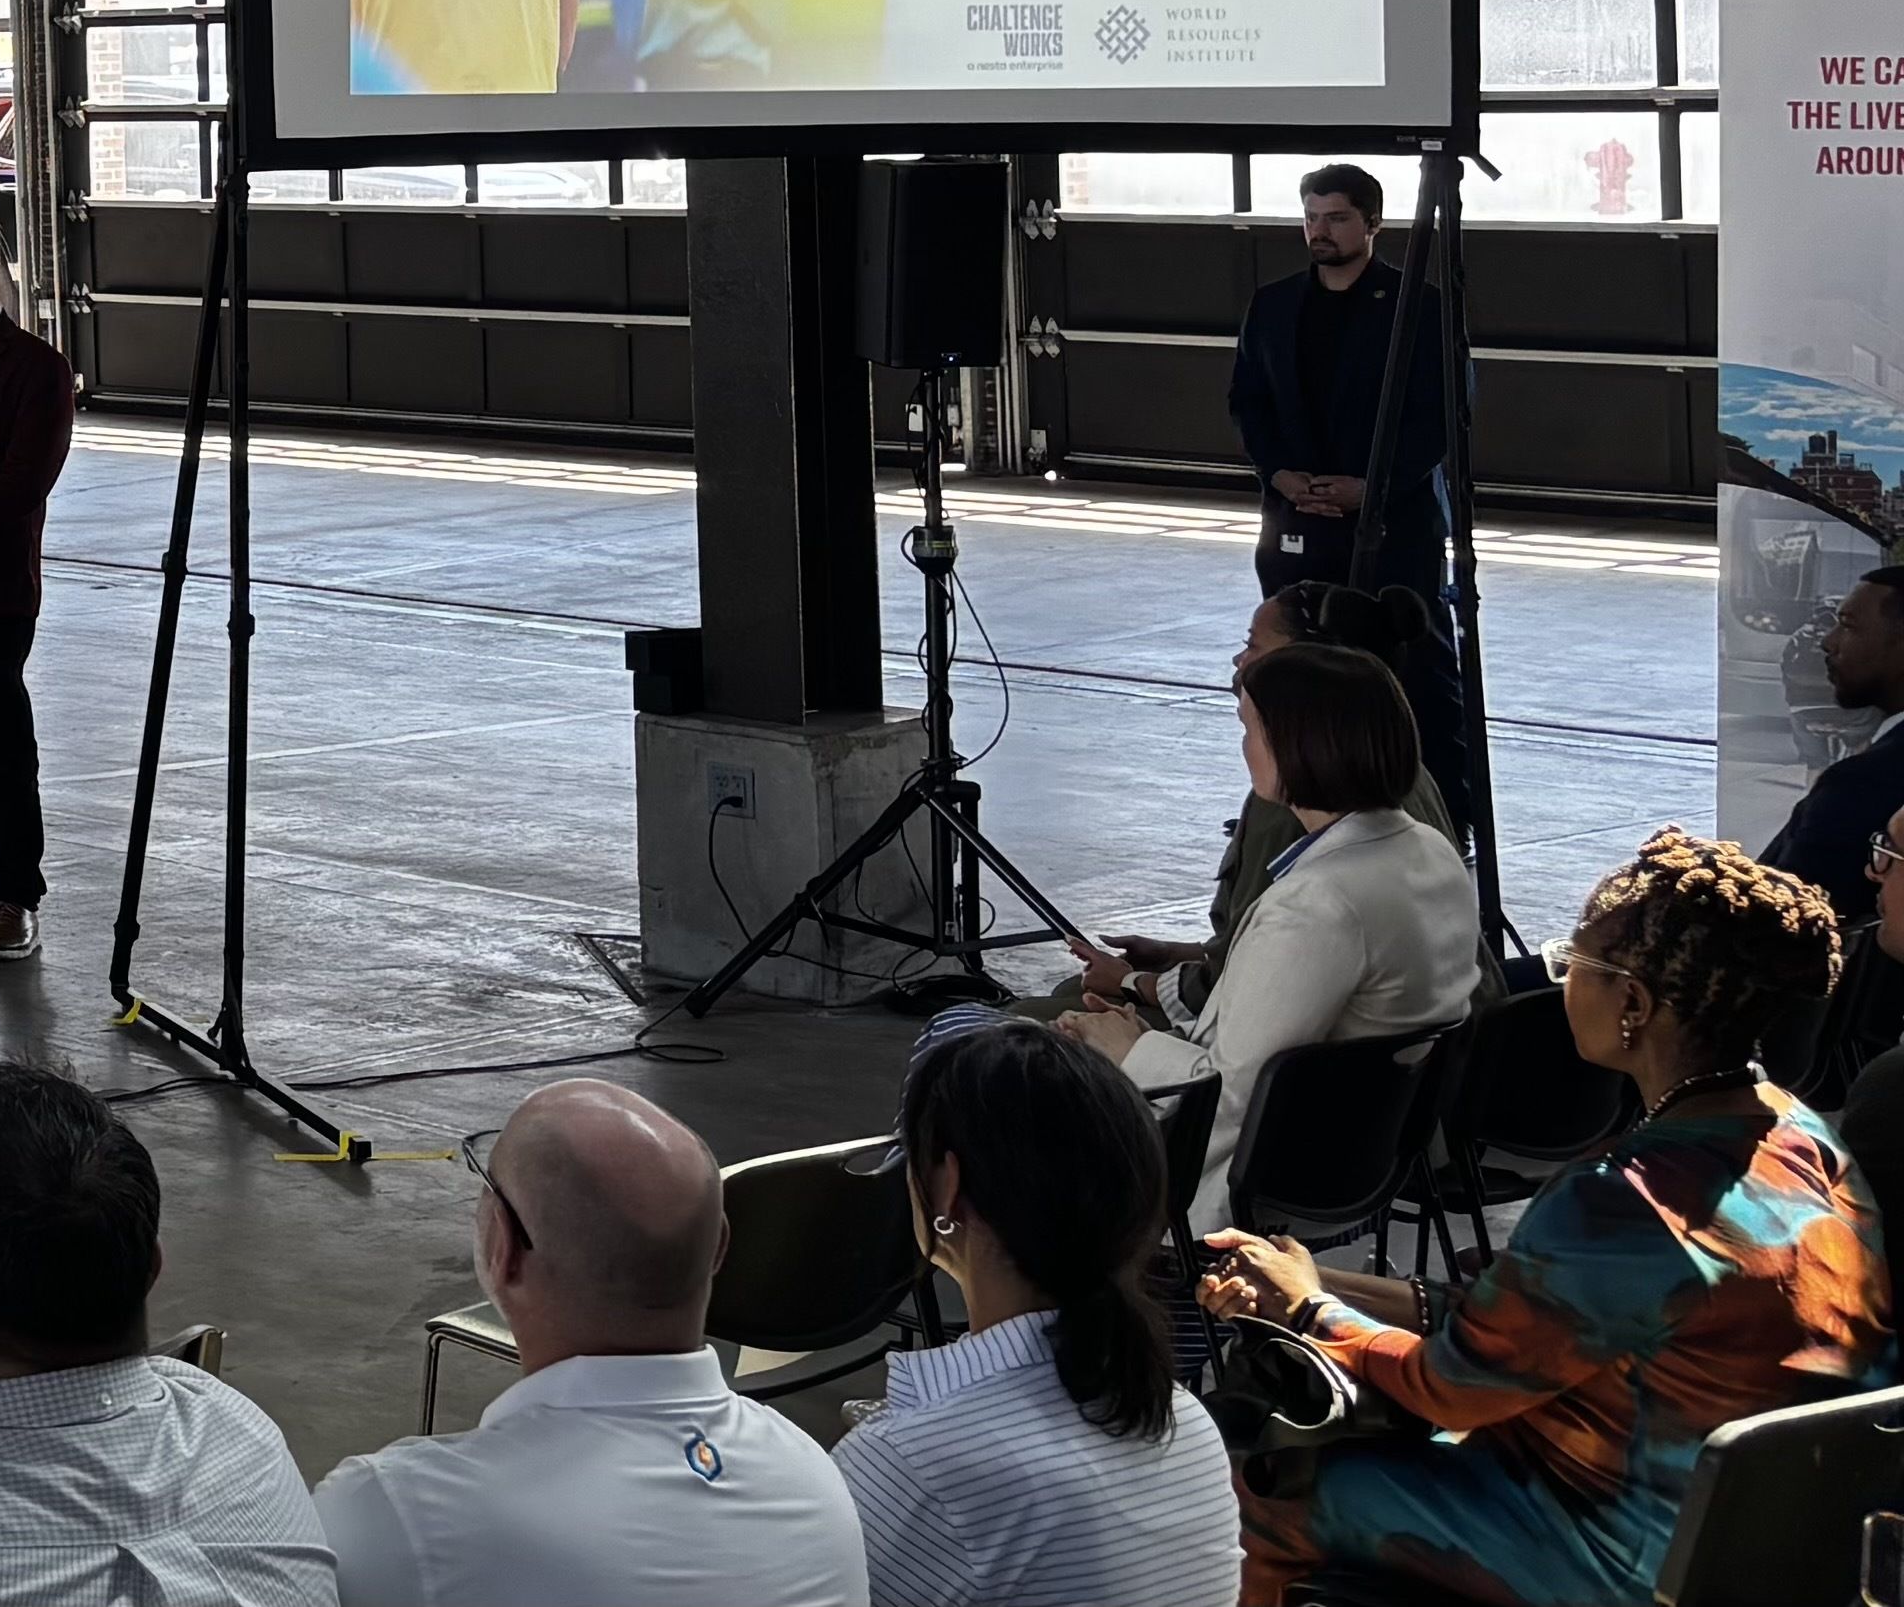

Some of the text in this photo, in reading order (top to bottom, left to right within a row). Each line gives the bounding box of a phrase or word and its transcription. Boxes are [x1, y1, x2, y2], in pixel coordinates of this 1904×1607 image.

[1166, 8, 1227, 20] WORLD
[1003, 32, 1063, 56] WORKS
[1167, 29, 1262, 42] RESOURCES
[1167, 50, 1256, 63] INSTITUTE
[1820, 57, 1865, 85] WE
[1786, 101, 1904, 130] THE LIVE
